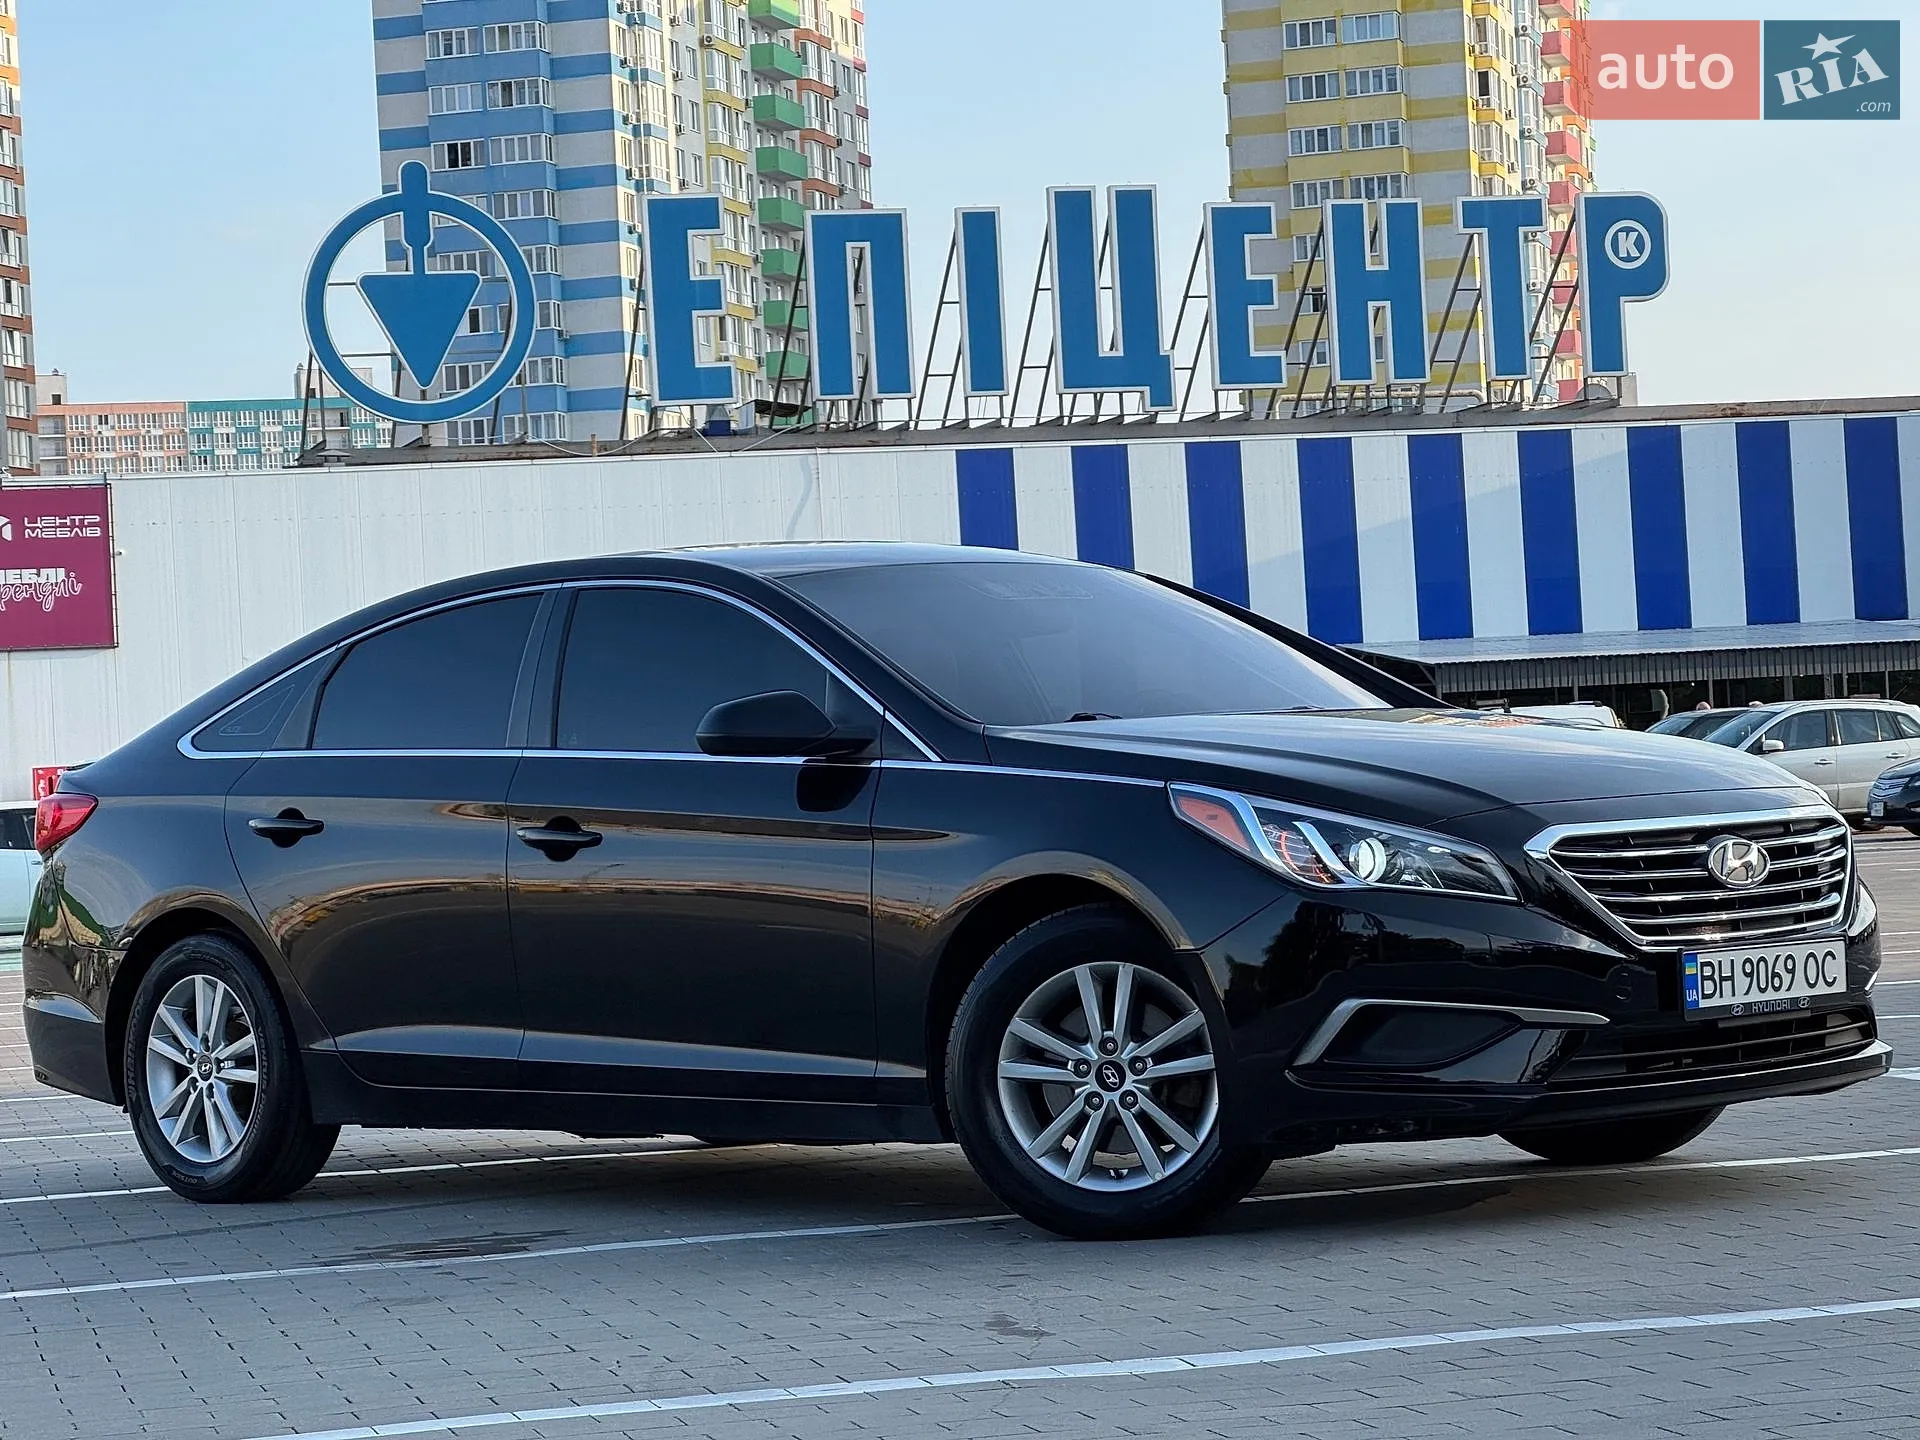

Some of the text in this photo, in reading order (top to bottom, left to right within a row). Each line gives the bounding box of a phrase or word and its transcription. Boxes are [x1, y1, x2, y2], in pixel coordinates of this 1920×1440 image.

[642, 185, 1670, 411] ЕПІЦЕНТР
[24, 516, 101, 527] ЦЕНТР
[24, 528, 101, 539] МЕБЛІВ
[1699, 948, 1838, 1000] BH 9069 OC
[1686, 989, 1698, 1002] UA
[1752, 999, 1791, 1013] HYUNDAI
